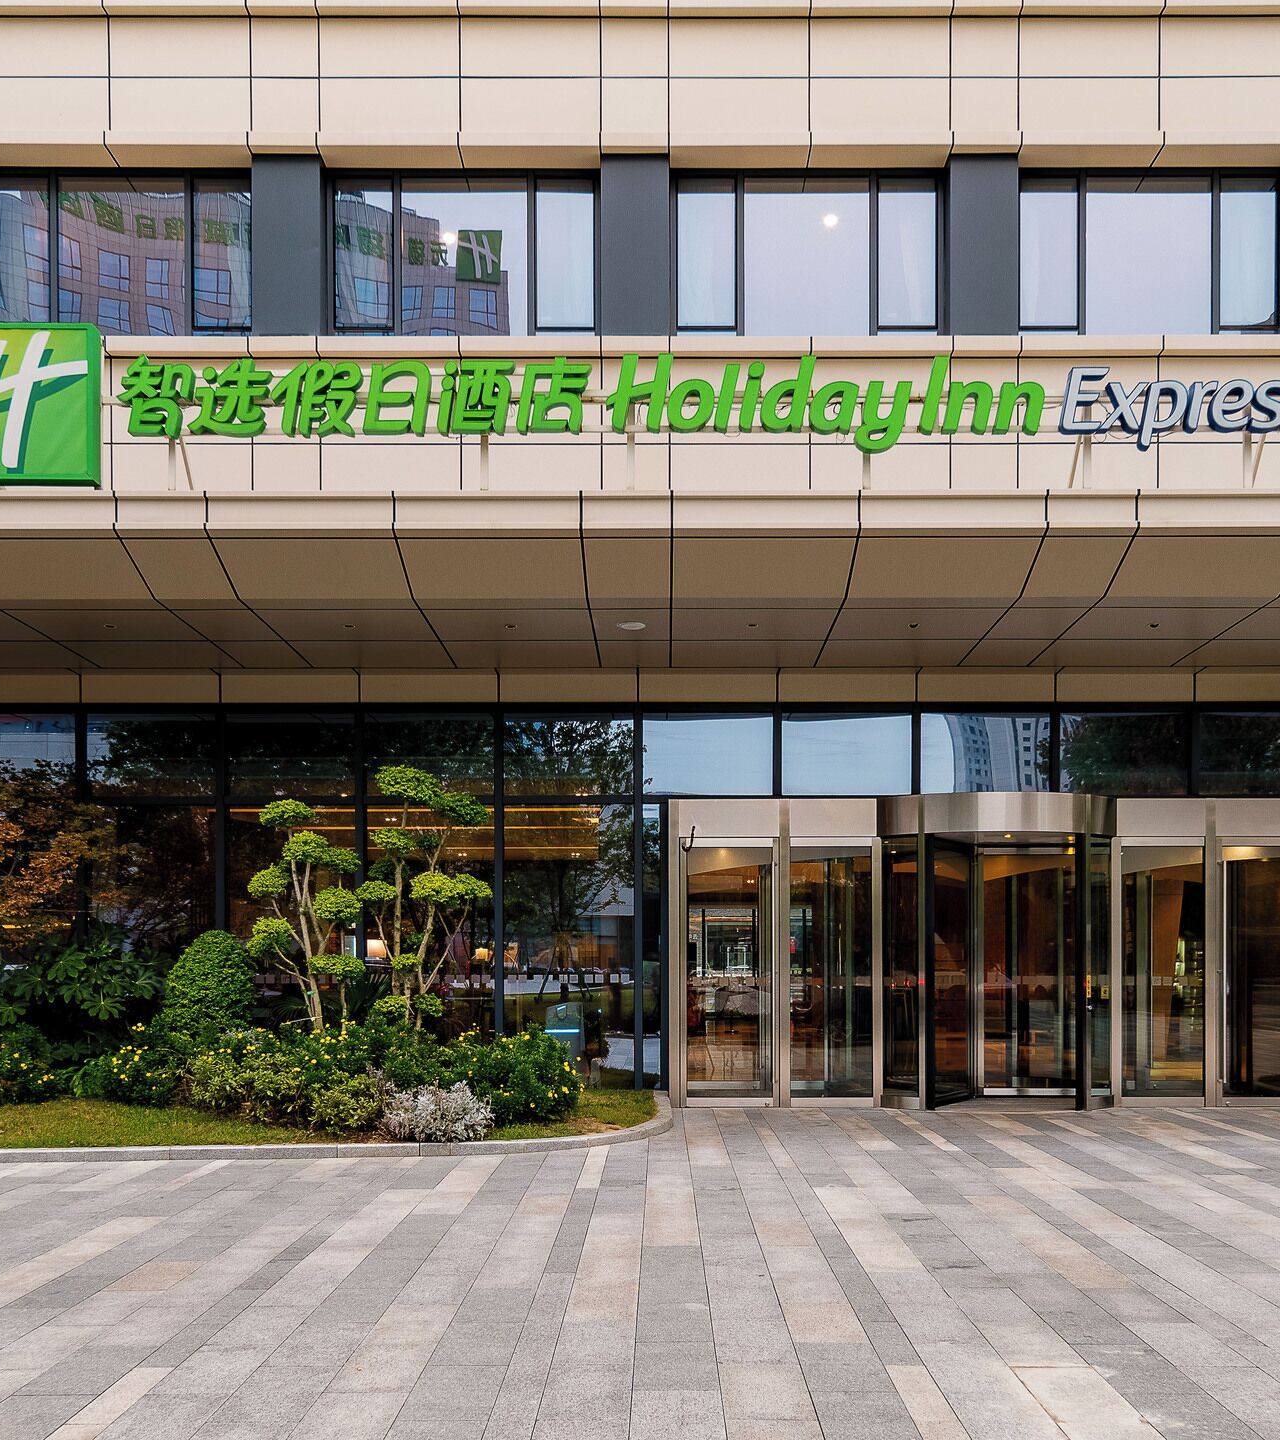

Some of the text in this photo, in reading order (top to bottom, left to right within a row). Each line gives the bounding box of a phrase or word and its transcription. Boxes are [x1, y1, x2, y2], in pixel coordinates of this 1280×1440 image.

[117, 355, 593, 439] 智选假日酒店
